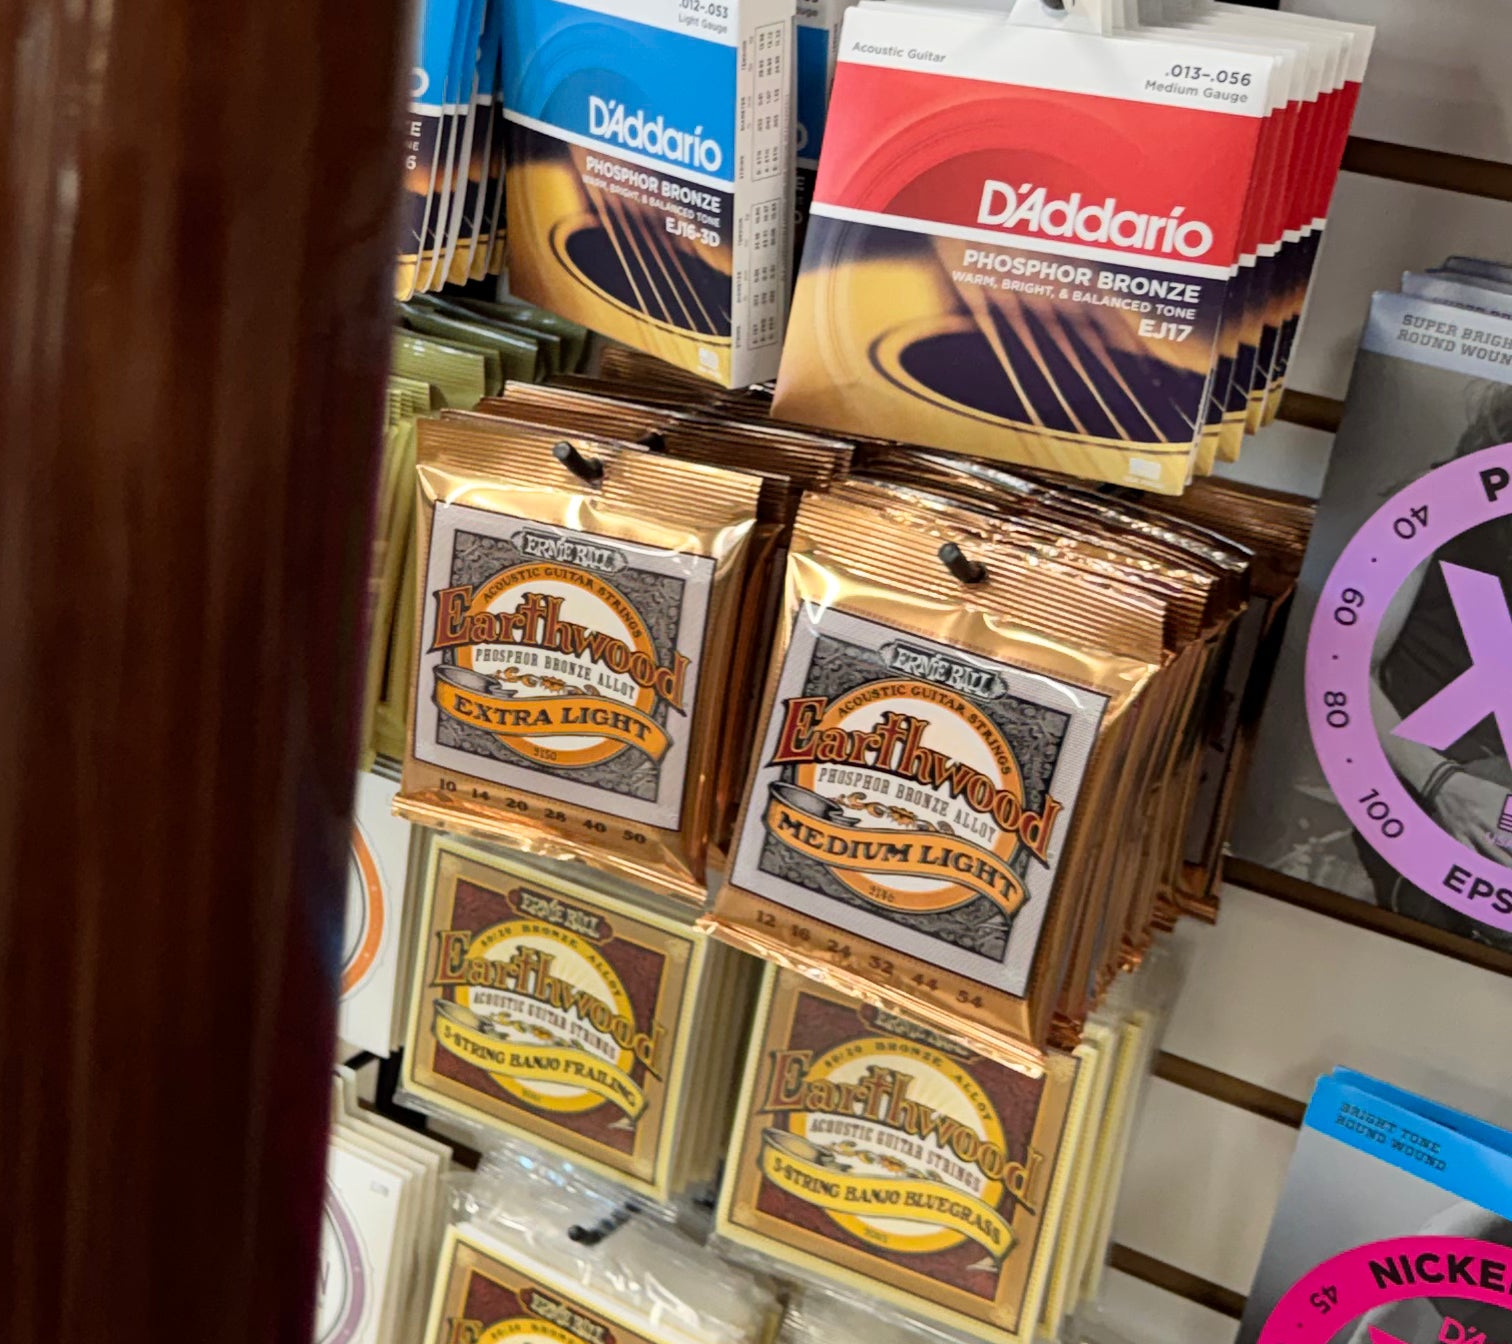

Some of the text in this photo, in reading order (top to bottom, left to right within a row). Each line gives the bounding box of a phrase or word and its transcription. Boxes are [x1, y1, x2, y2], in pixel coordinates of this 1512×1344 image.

[852, 40, 946, 65] Acoustic Guitar
[1164, 63, 1252, 87] .013-.056
[1144, 79, 1249, 105] Medium Gauge
[586, 155, 721, 213] PHOSPHOR BRONZE
[666, 216, 720, 247] EJ16-3D
[952, 270, 1196, 321] WARM, BRIGHT, BALANCED TONE
[963, 249, 1202, 304] PHOSPHOR BRONZE
[1138, 319, 1194, 343] EJ17
[1397, 329, 1456, 352] ROUND
[1402, 314, 1457, 337] SUPER
[525, 536, 615, 572] ERNIE BALL
[483, 568, 643, 640] ACOUSTIC GUITAR STRINGS
[1334, 587, 1365, 627] 60
[427, 585, 692, 717] Earthwood
[475, 648, 636, 700] PHOSPHOR BRONZE ALLOY
[892, 646, 951, 684] ERNIE
[453, 696, 652, 743] EXTRA LIGHT
[837, 683, 1013, 776] ACOUSTIC GUITAR STRINGS
[1323, 690, 1350, 729] 80
[765, 696, 1064, 870] Earthwood
[817, 768, 997, 844] PHOSPHOR BRONZE ALLOY
[1359, 788, 1405, 839] 100
[775, 810, 1019, 902] MEDIUM LIGHT
[430, 930, 667, 1081] Earthwood
[442, 1025, 636, 1108] 5-STRING BANJO FRAILING
[758, 1050, 1044, 1216] Earthwood
[1335, 1113, 1447, 1173] ROUND WOUND
[1341, 1101, 1443, 1155] BRIGHT TONE
[772, 1158, 1002, 1245] 5-STRING BANJO BLUEGRASS
[1309, 1283, 1338, 1314] 45
